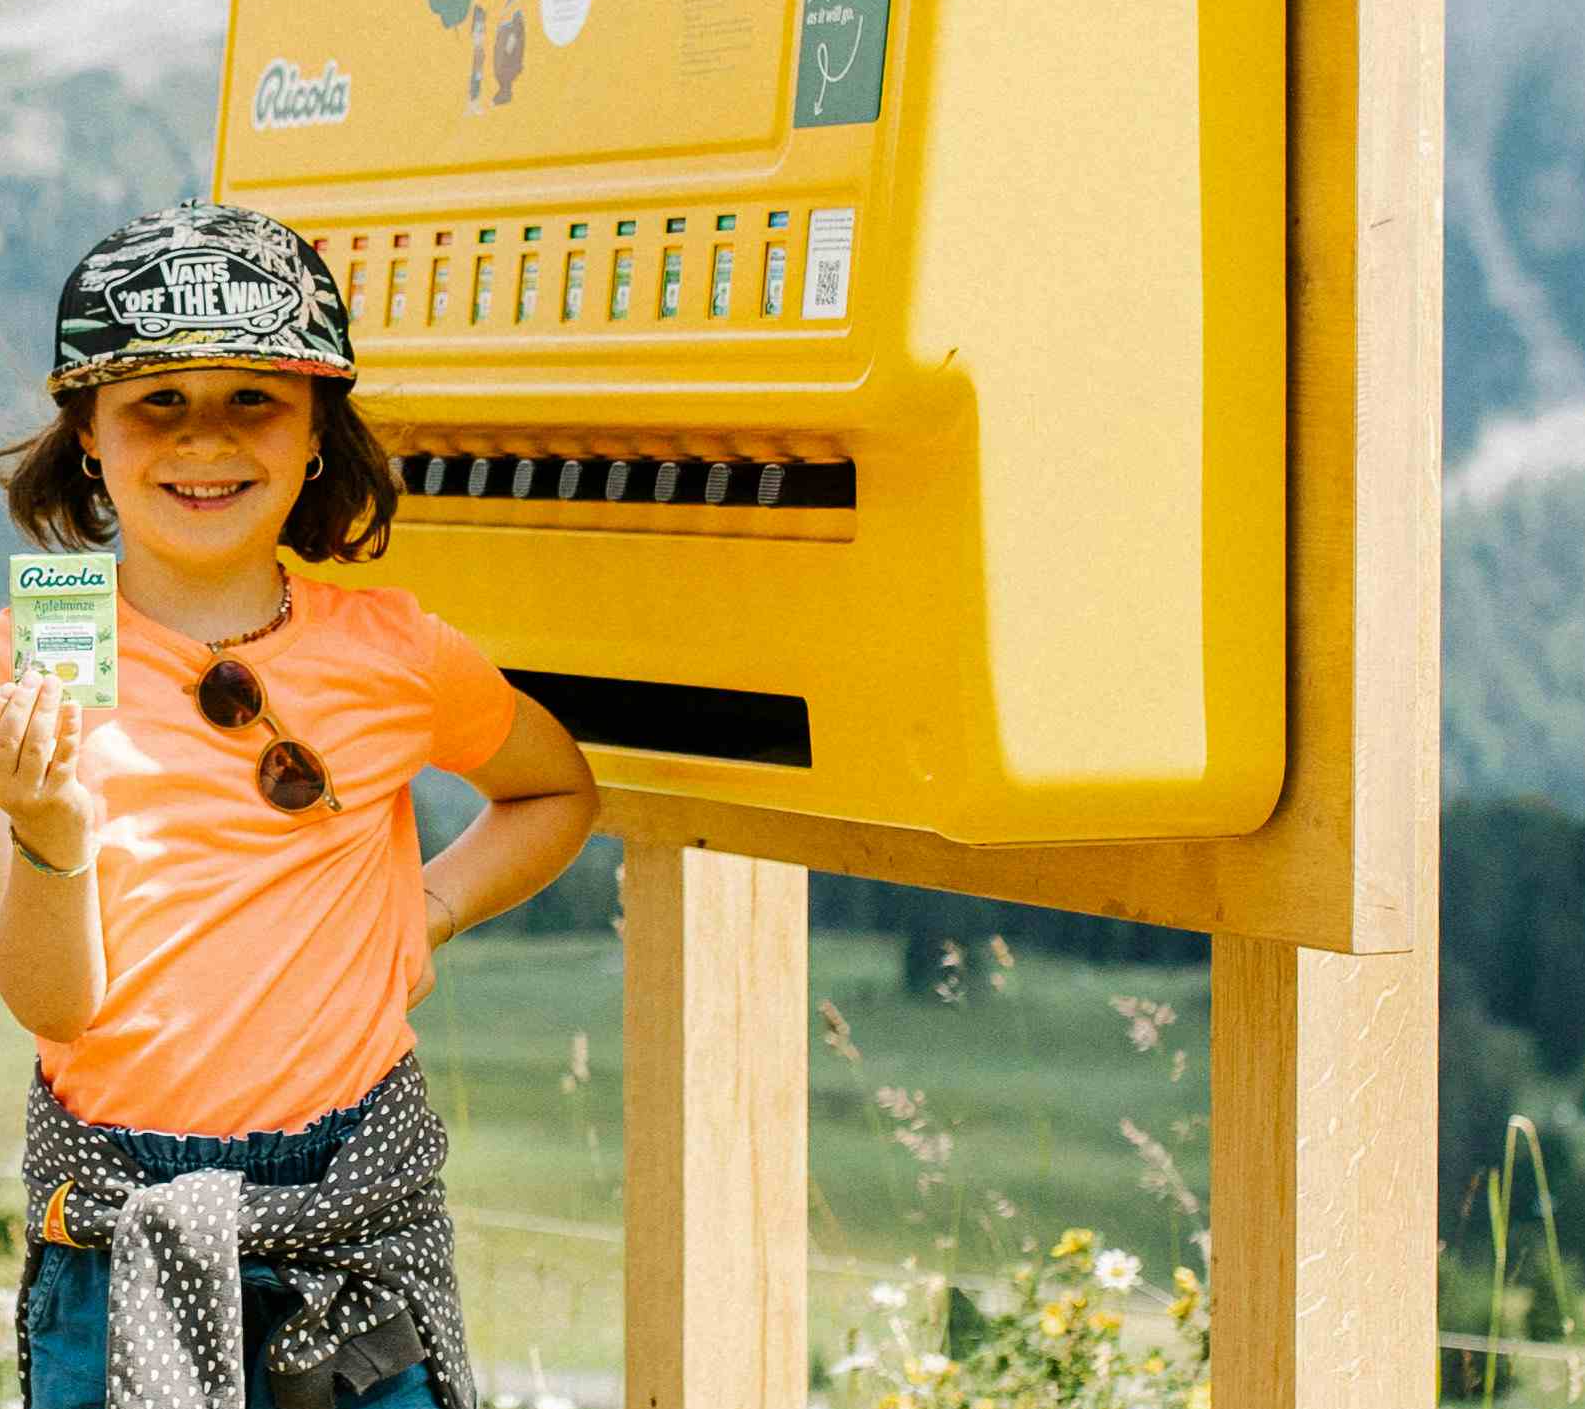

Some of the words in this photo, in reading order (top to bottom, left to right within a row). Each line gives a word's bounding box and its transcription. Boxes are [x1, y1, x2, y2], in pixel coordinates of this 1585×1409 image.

[807, 13, 817, 25] as
[817, 8, 825, 24] it
[826, 5, 841, 23] will
[255, 64, 347, 122] Ricola
[159, 256, 230, 285] VANS
[167, 283, 220, 315] THE
[20, 566, 105, 589] Ricola
